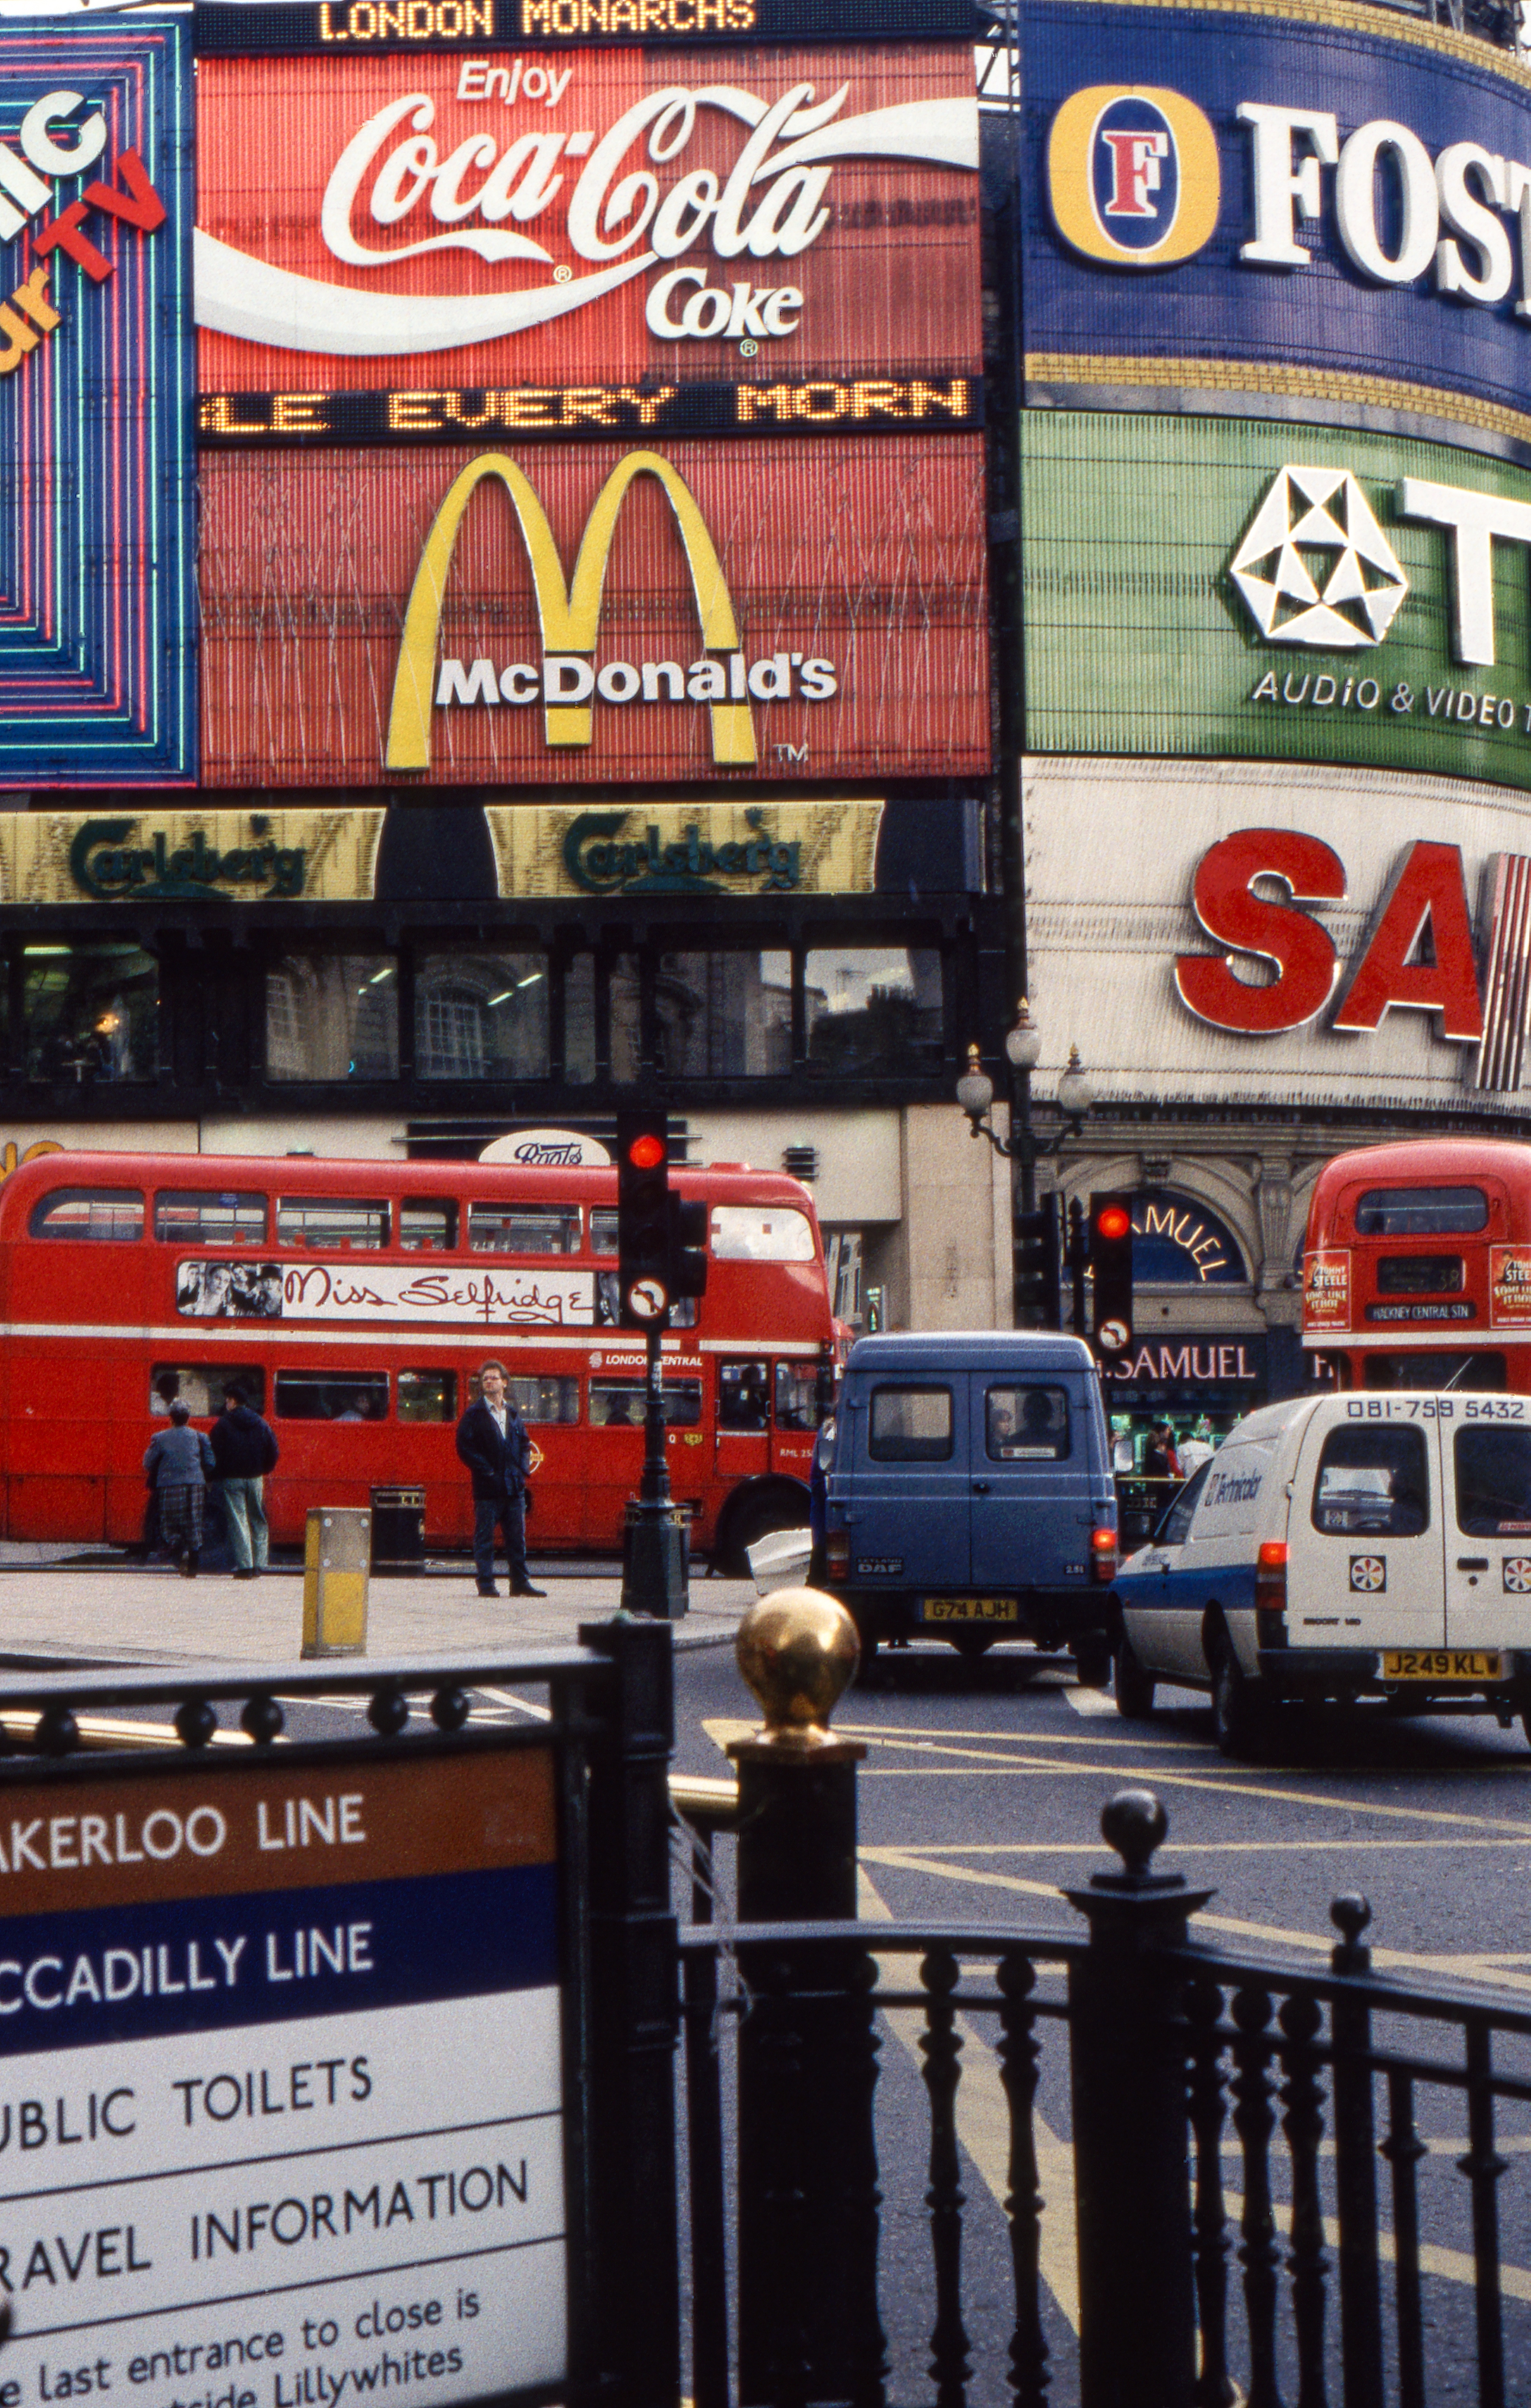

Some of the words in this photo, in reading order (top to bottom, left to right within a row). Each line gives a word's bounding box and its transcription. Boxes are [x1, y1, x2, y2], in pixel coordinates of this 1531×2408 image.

[321, 1, 492, 40] LONDON
[522, 0, 756, 34] MONARCHS
[456, 60, 572, 106] Enjoy
[322, 82, 850, 266] Coca-Cola
[32, 147, 167, 283] TV
[645, 267, 805, 341] Coke
[388, 387, 677, 429] EVERY
[737, 379, 969, 420] MORN
[435, 652, 837, 705] McDonald's
[1252, 671, 1380, 710] AUDIO
[1390, 682, 1415, 713] &
[1427, 686, 1514, 729] VIDEO
[70, 816, 307, 900] Carlsberg
[563, 810, 801, 892] Carlsberg
[1131, 1204, 1227, 1282] MUEL
[284, 1266, 398, 1307] Miss
[398, 1275, 595, 1324] Selfridge
[1313, 1275, 1348, 1287] STEELE
[606, 1355, 647, 1366] LONDO
[660, 1356, 703, 1366] ENTRAL
[1348, 1400, 1454, 1418] 081-759
[1465, 1401, 1524, 1419] 5432
[779, 1448, 798, 1457] RML
[858, 1563, 903, 1573] DAF
[974, 1601, 1009, 1619] AJH
[1389, 1655, 1449, 1674] J249
[257, 1793, 366, 1851] LINE
[266, 1922, 374, 1982] LINE
[173, 2055, 372, 2127] TOILETS
[191, 2159, 528, 2261] INFORMATION
[39, 2357, 111, 2401] last
[127, 2331, 285, 2385] entrance
[301, 2318, 339, 2350] to
[355, 2300, 442, 2340] close
[456, 2286, 480, 2320] is
[274, 2346, 464, 2408] Lillywhites
